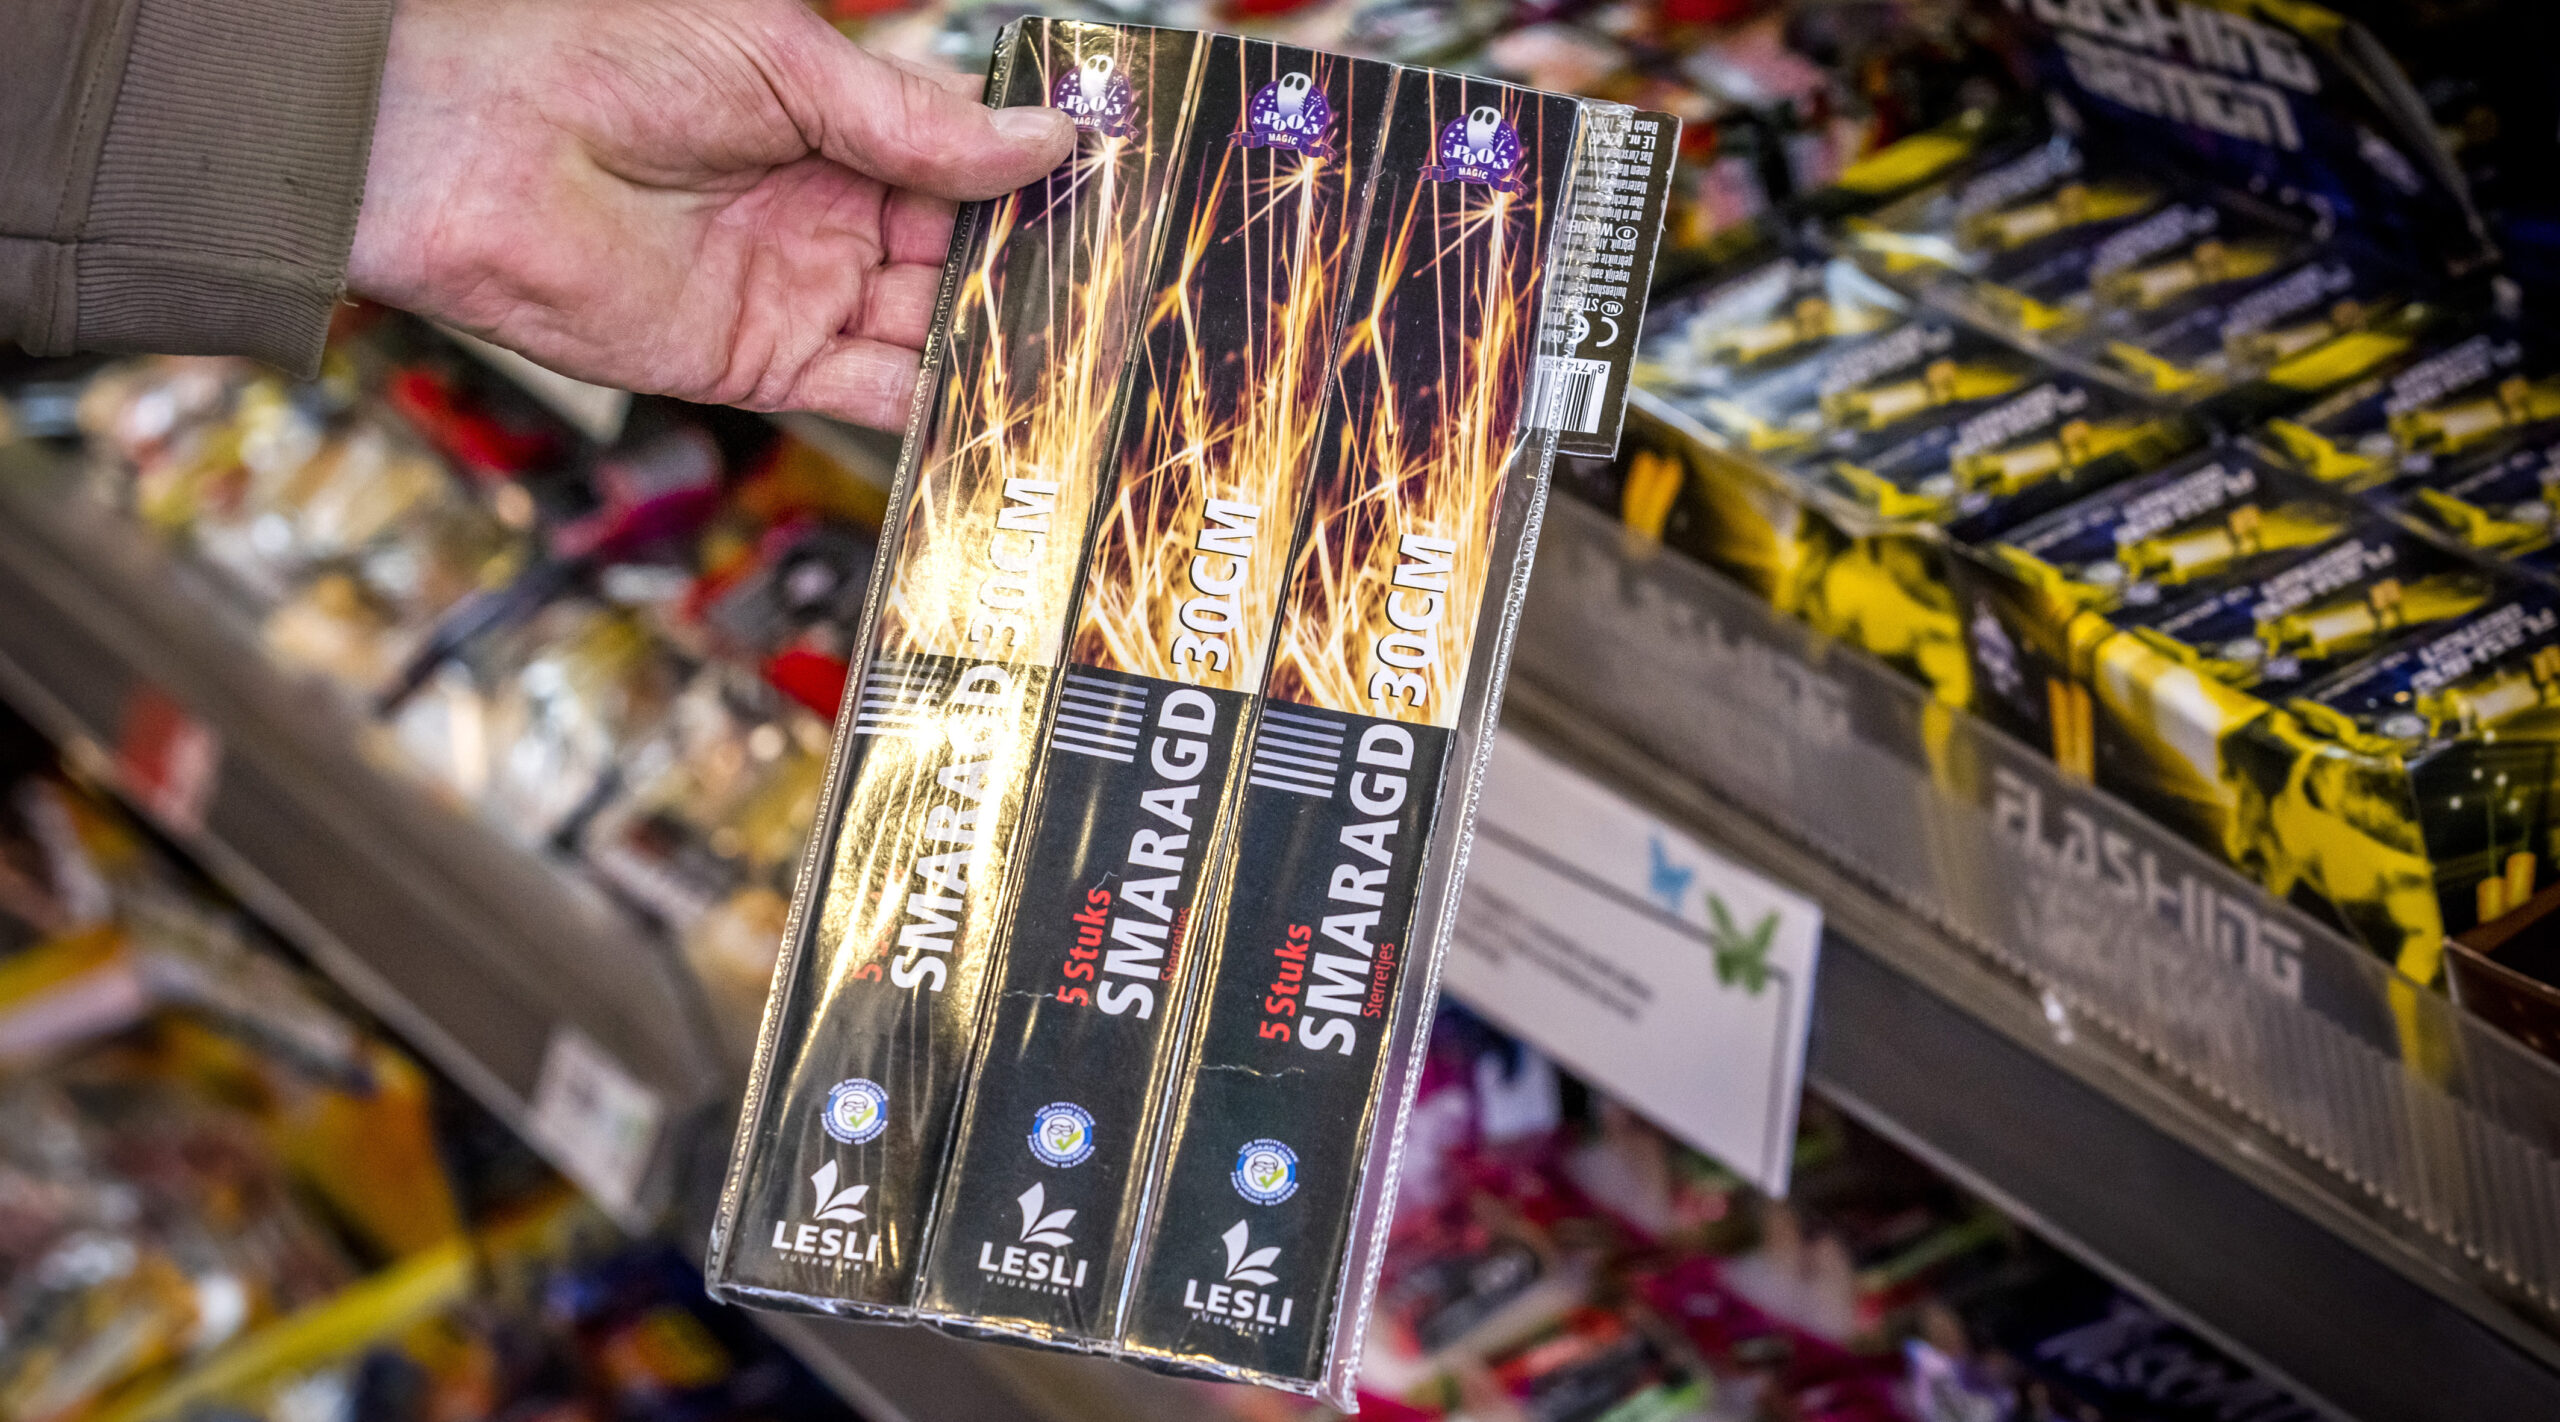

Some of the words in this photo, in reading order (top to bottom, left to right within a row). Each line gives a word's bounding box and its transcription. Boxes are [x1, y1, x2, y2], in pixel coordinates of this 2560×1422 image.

[1057, 95, 1126, 116] SPOOKY
[1252, 110, 1324, 135] SPOOKY
[1634, 119, 1659, 135] Batch
[1268, 133, 1298, 145] MAGIC
[1627, 134, 1641, 145] nr.
[1642, 135, 1656, 150] LE
[1442, 143, 1514, 170] SPOOKY
[1640, 151, 1654, 165] Das
[1458, 167, 1488, 180] MAGIC
[1622, 209, 1630, 222] in
[1600, 253, 1633, 268] gebruikte
[1588, 283, 1627, 299] buitenshuis
[1605, 303, 1619, 313] NL
[1598, 364, 1606, 373] 8
[1096, 689, 1216, 1020] SMARAGD
[1170, 498, 1261, 673] 30CM
[1298, 724, 1415, 1056] SMARAGD
[1368, 534, 1456, 708] 30CM
[890, 665, 1011, 993] SMARAD
[1063, 889, 1111, 982] Stuks
[853, 963, 883, 983] 5
[1264, 924, 1313, 1017] Stuks
[1362, 943, 1395, 1018] Sterretjes
[1057, 984, 1090, 1007] 5
[1259, 1020, 1292, 1042] 5
[771, 1220, 879, 1262] LESLI
[779, 1252, 861, 1271] VUURWRK
[978, 1241, 1088, 1288] LESLI
[1184, 1279, 1294, 1327] LESLI
